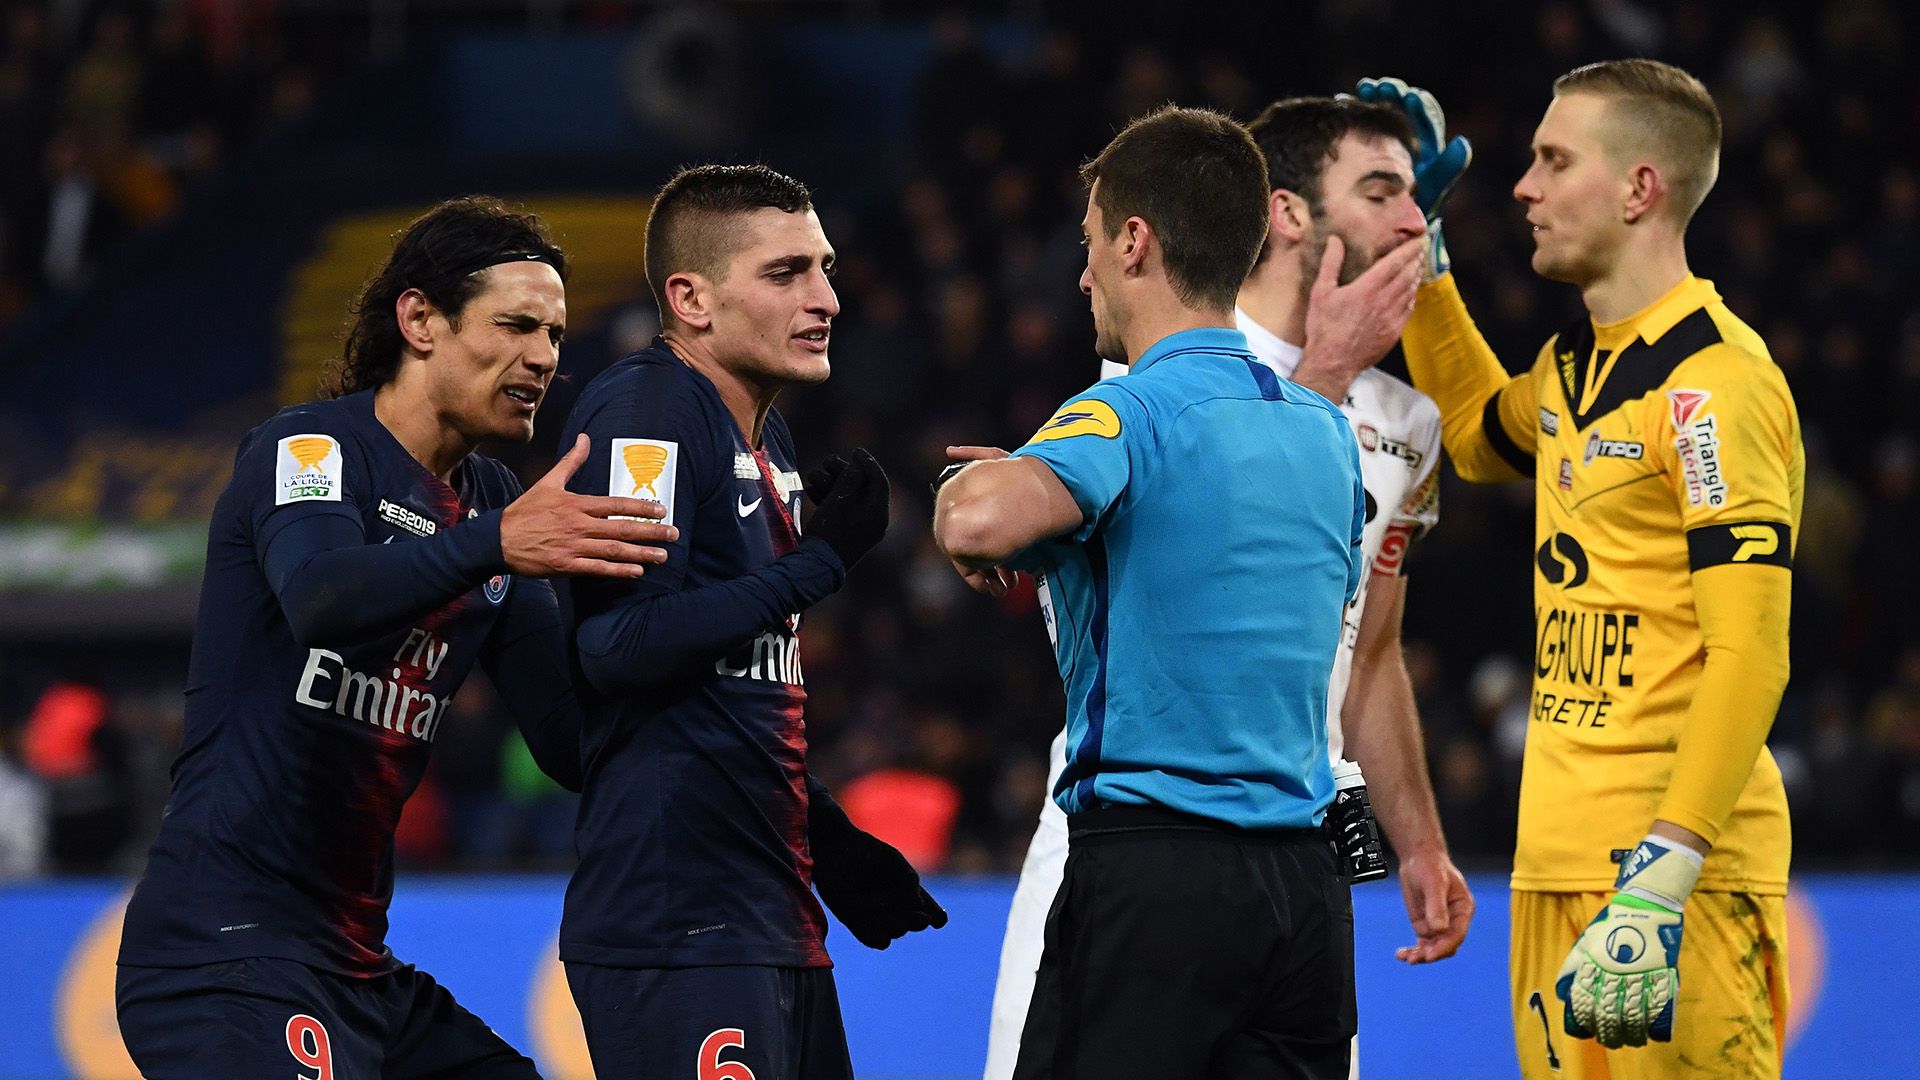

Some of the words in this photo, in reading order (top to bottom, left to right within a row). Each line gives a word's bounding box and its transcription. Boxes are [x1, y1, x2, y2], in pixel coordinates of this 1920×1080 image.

[284, 479, 298, 488] LA
[301, 478, 334, 488] LIGUE
[1695, 418, 1724, 505] Triangle
[289, 486, 329, 499] BKT
[378, 498, 436, 535] PES2019
[393, 628, 449, 680] Fly
[285, 1014, 334, 1080] 9
[697, 1028, 756, 1080] 6
[1529, 992, 1561, 1070] 1
